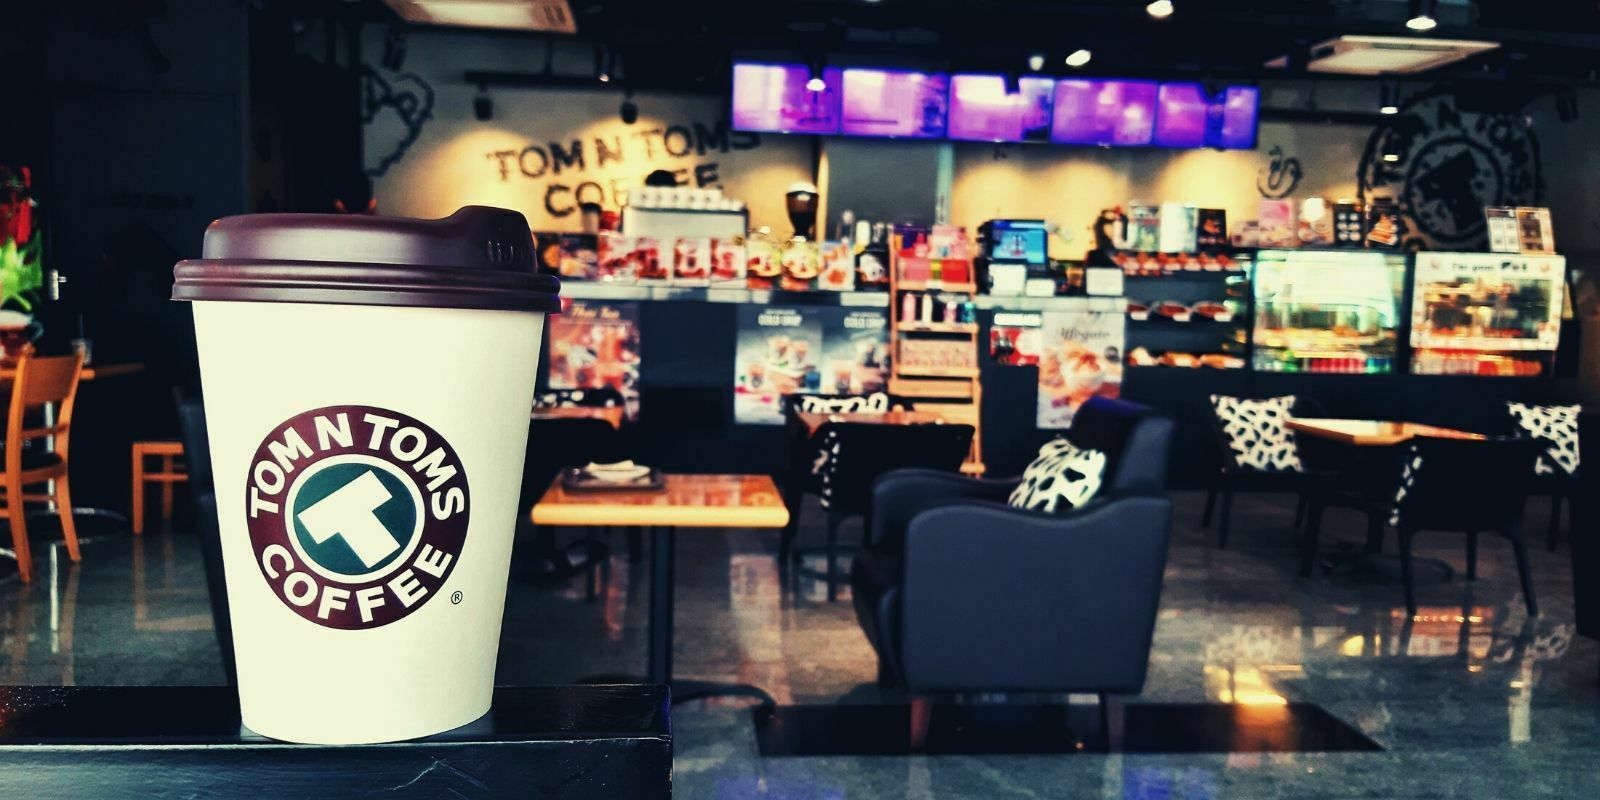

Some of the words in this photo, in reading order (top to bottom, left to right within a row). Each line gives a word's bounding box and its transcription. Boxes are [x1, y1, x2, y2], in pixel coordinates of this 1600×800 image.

[486, 139, 585, 183] TOM
[596, 136, 624, 169] N
[251, 427, 315, 518] TOM
[315, 413, 353, 450] N
[363, 413, 464, 521] TOMS
[262, 543, 453, 623] COFFEE
